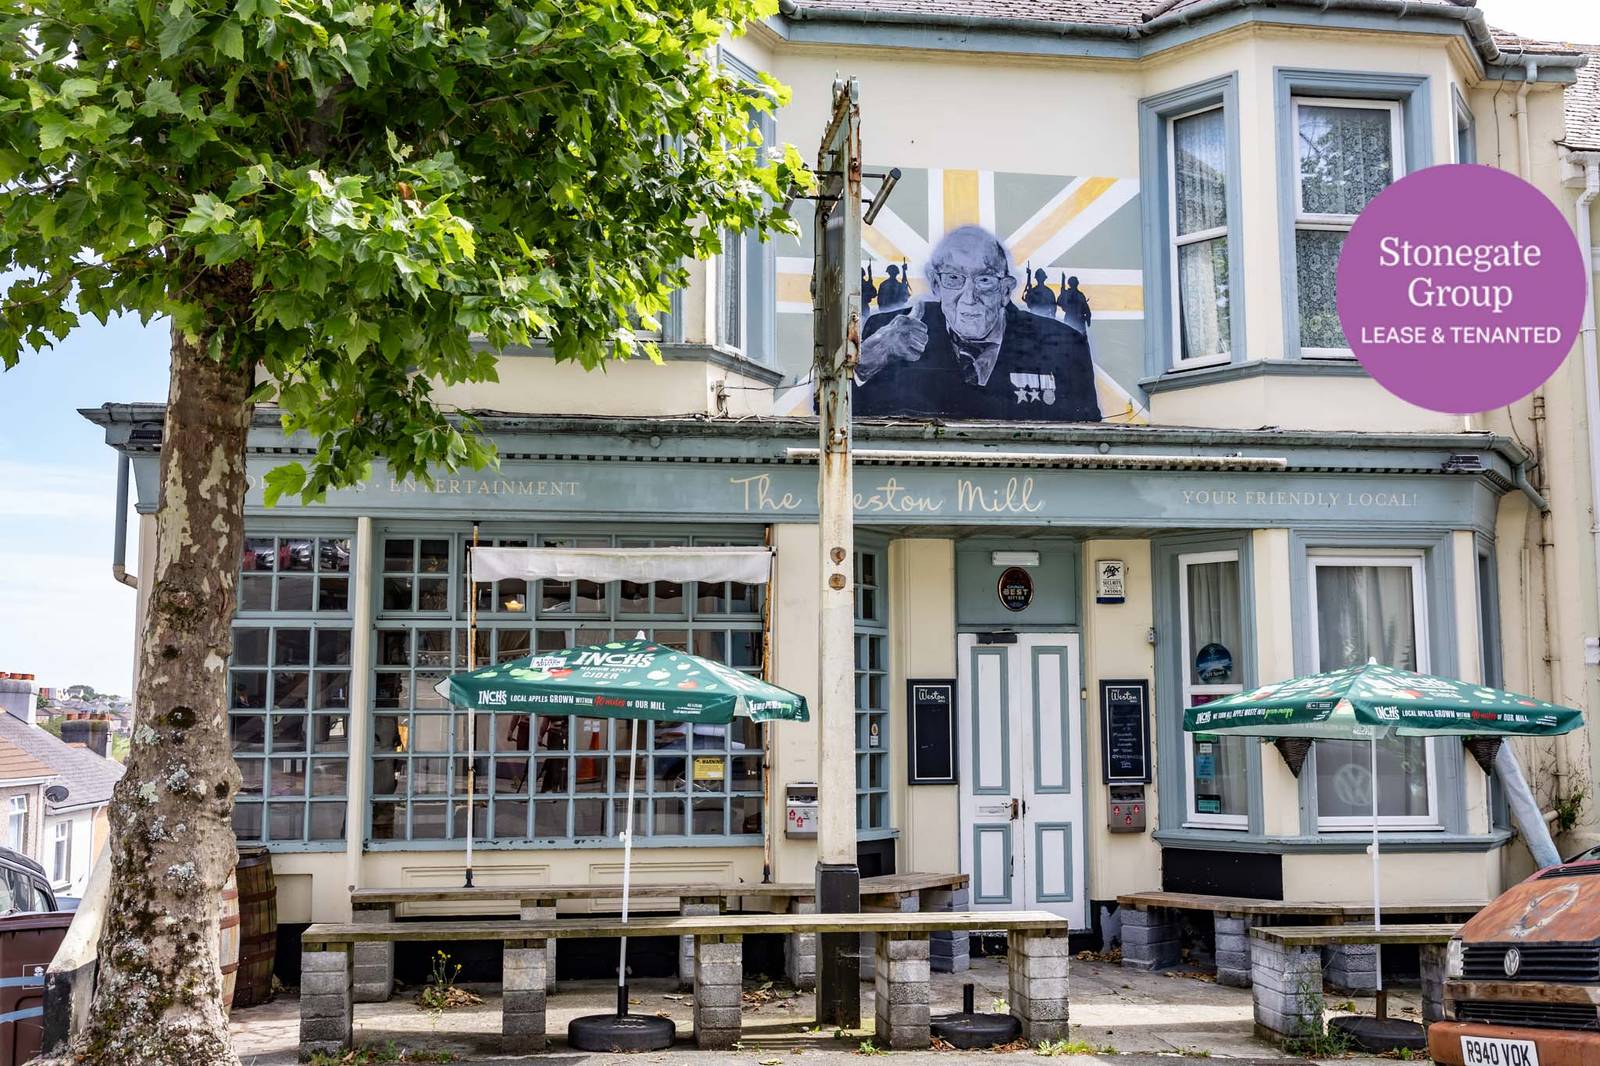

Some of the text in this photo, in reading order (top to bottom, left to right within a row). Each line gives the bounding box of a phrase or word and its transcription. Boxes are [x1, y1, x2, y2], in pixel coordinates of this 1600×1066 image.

[390, 478, 580, 496] ENERTAINMENT
[730, 473, 1046, 512] The eston Mill
[1182, 490, 1417, 507] YOUR FRIENDLY LOCAL!
[1003, 588, 1029, 596] BEST
[582, 672, 619, 680] CIDER
[510, 694, 527, 702] LOCAL
[528, 695, 548, 703] APPLES
[549, 694, 574, 704] GROWN
[635, 700, 649, 709] OUR
[650, 700, 666, 711] MILL
[919, 689, 946, 701] Weston
[1111, 689, 1137, 701] Weston
[1402, 709, 1417, 717] LOCAL
[1417, 710, 1434, 718] APPLES
[1434, 709, 1455, 718] GROWN
[1503, 713, 1514, 721] OUR
[1515, 714, 1529, 722] MILL
[1466, 1039, 1499, 1066] R940
